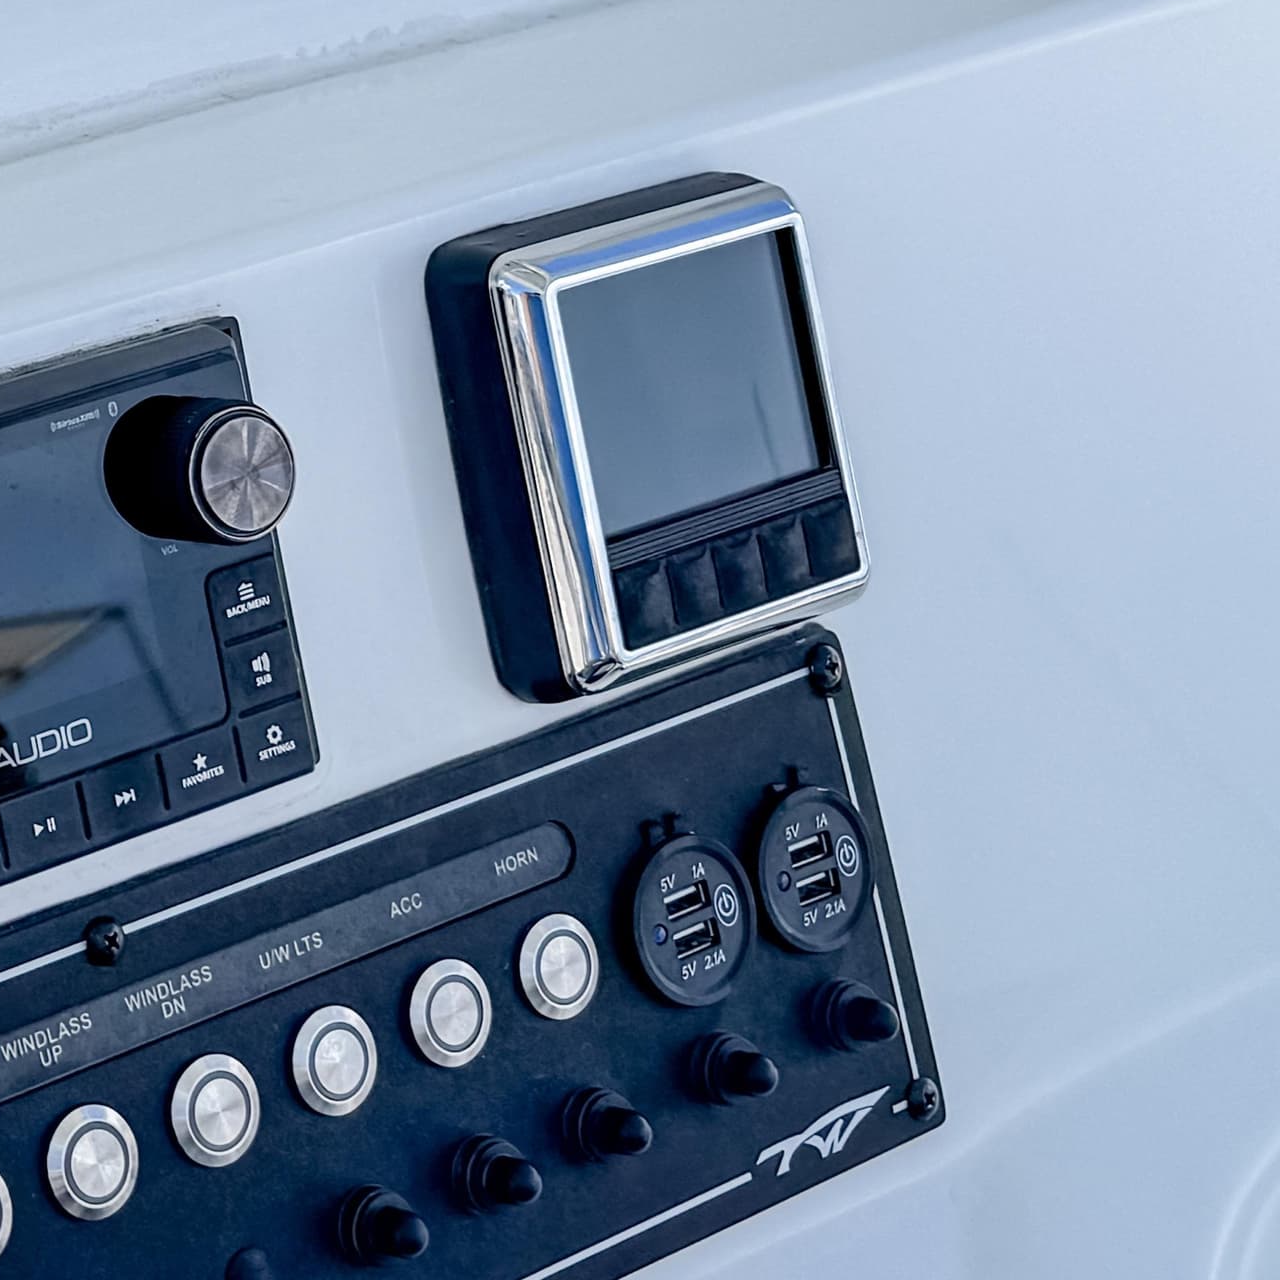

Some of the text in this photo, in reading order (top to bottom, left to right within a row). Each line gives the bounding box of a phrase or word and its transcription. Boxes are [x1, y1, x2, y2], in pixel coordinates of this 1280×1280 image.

[160, 544, 179, 556] VOL
[255, 673, 273, 687] SUB
[258, 740, 297, 761] SETTINGS
[182, 765, 225, 789] FAVORITES
[784, 813, 828, 841] 5V 1A
[494, 846, 539, 876] HORN
[660, 862, 706, 893] 5V 1A
[390, 892, 423, 918] ACC
[803, 898, 846, 927] 5V 2.1A
[258, 931, 324, 970] U/W LTS
[681, 949, 726, 981] 5V 2.1A
[124, 965, 213, 1012] WINDLASS
[161, 996, 186, 1019] DN
[0, 1012, 92, 1062] WINDLASS
[39, 1045, 63, 1068] UP
